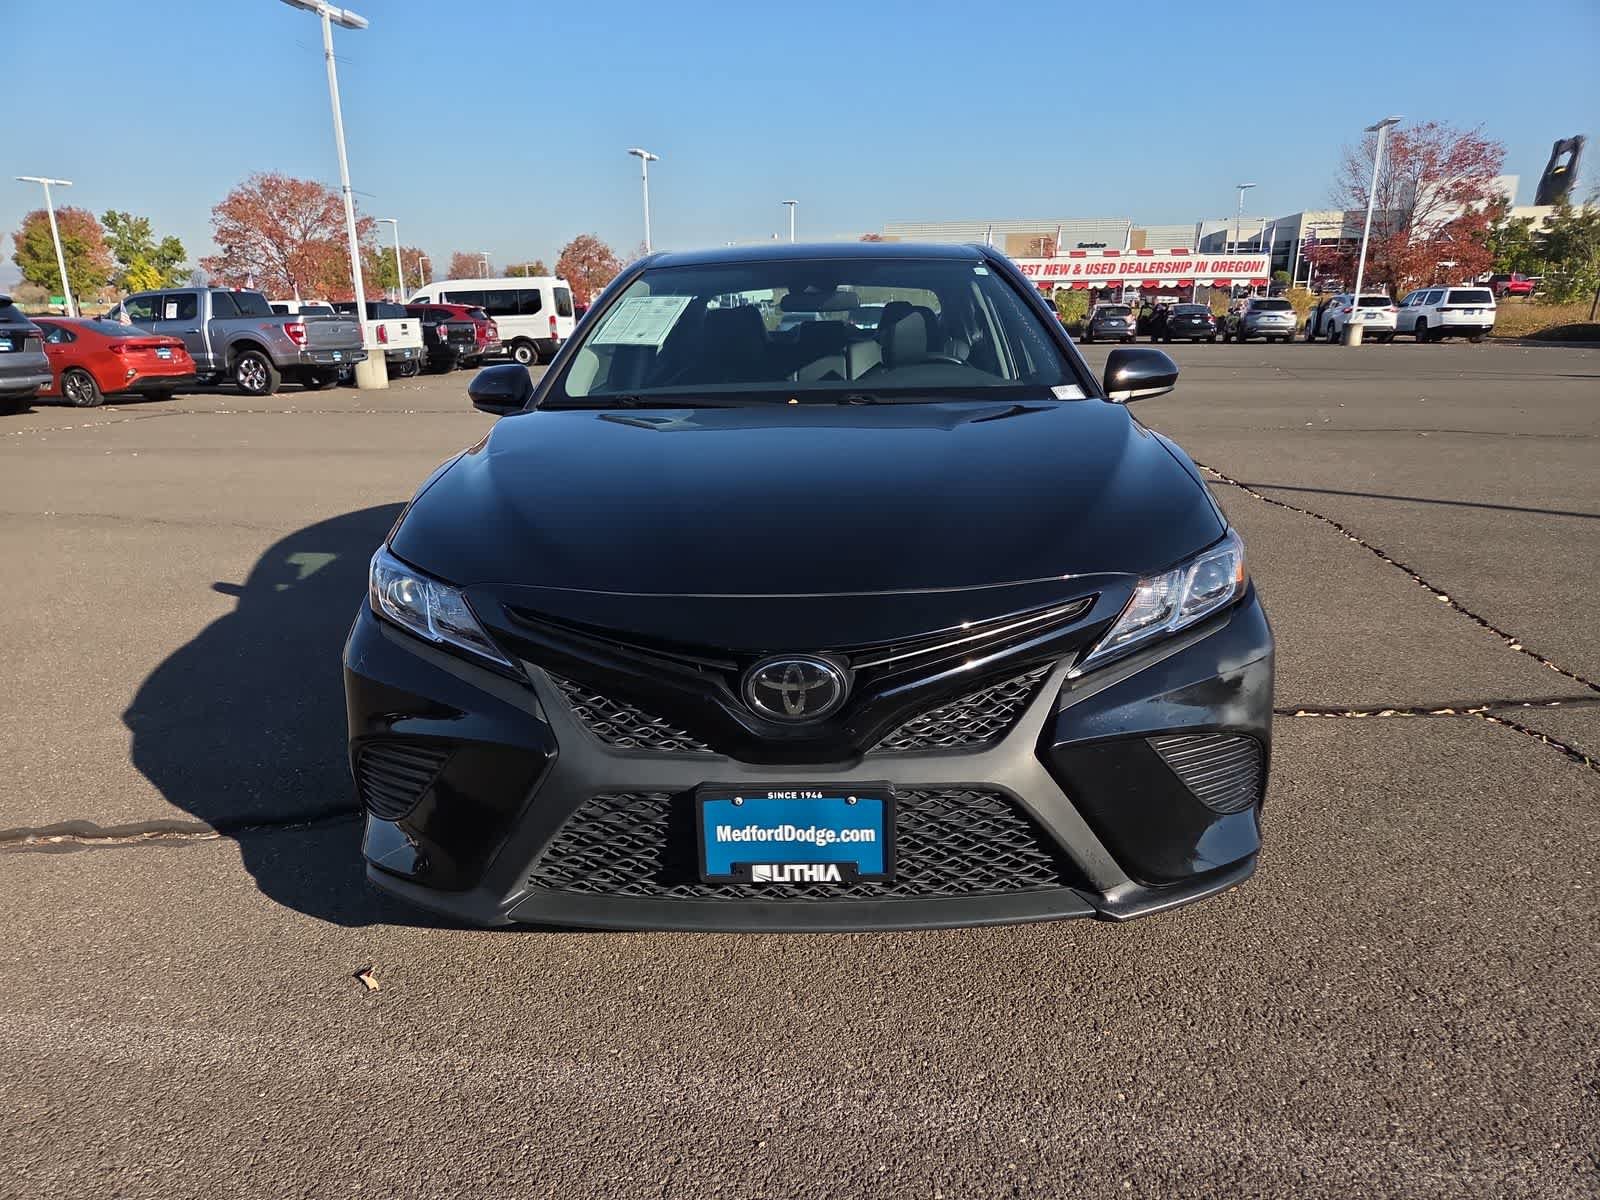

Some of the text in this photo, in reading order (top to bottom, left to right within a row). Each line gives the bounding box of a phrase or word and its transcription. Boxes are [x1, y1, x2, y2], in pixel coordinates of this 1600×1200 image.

[1016, 260, 1264, 276] EST NEW & USED DEALERSHIP IN OREGON!
[767, 791, 823, 799] SINCE 1946
[716, 825, 876, 846] MedfordDodge.com
[771, 864, 842, 882] LITHIA
